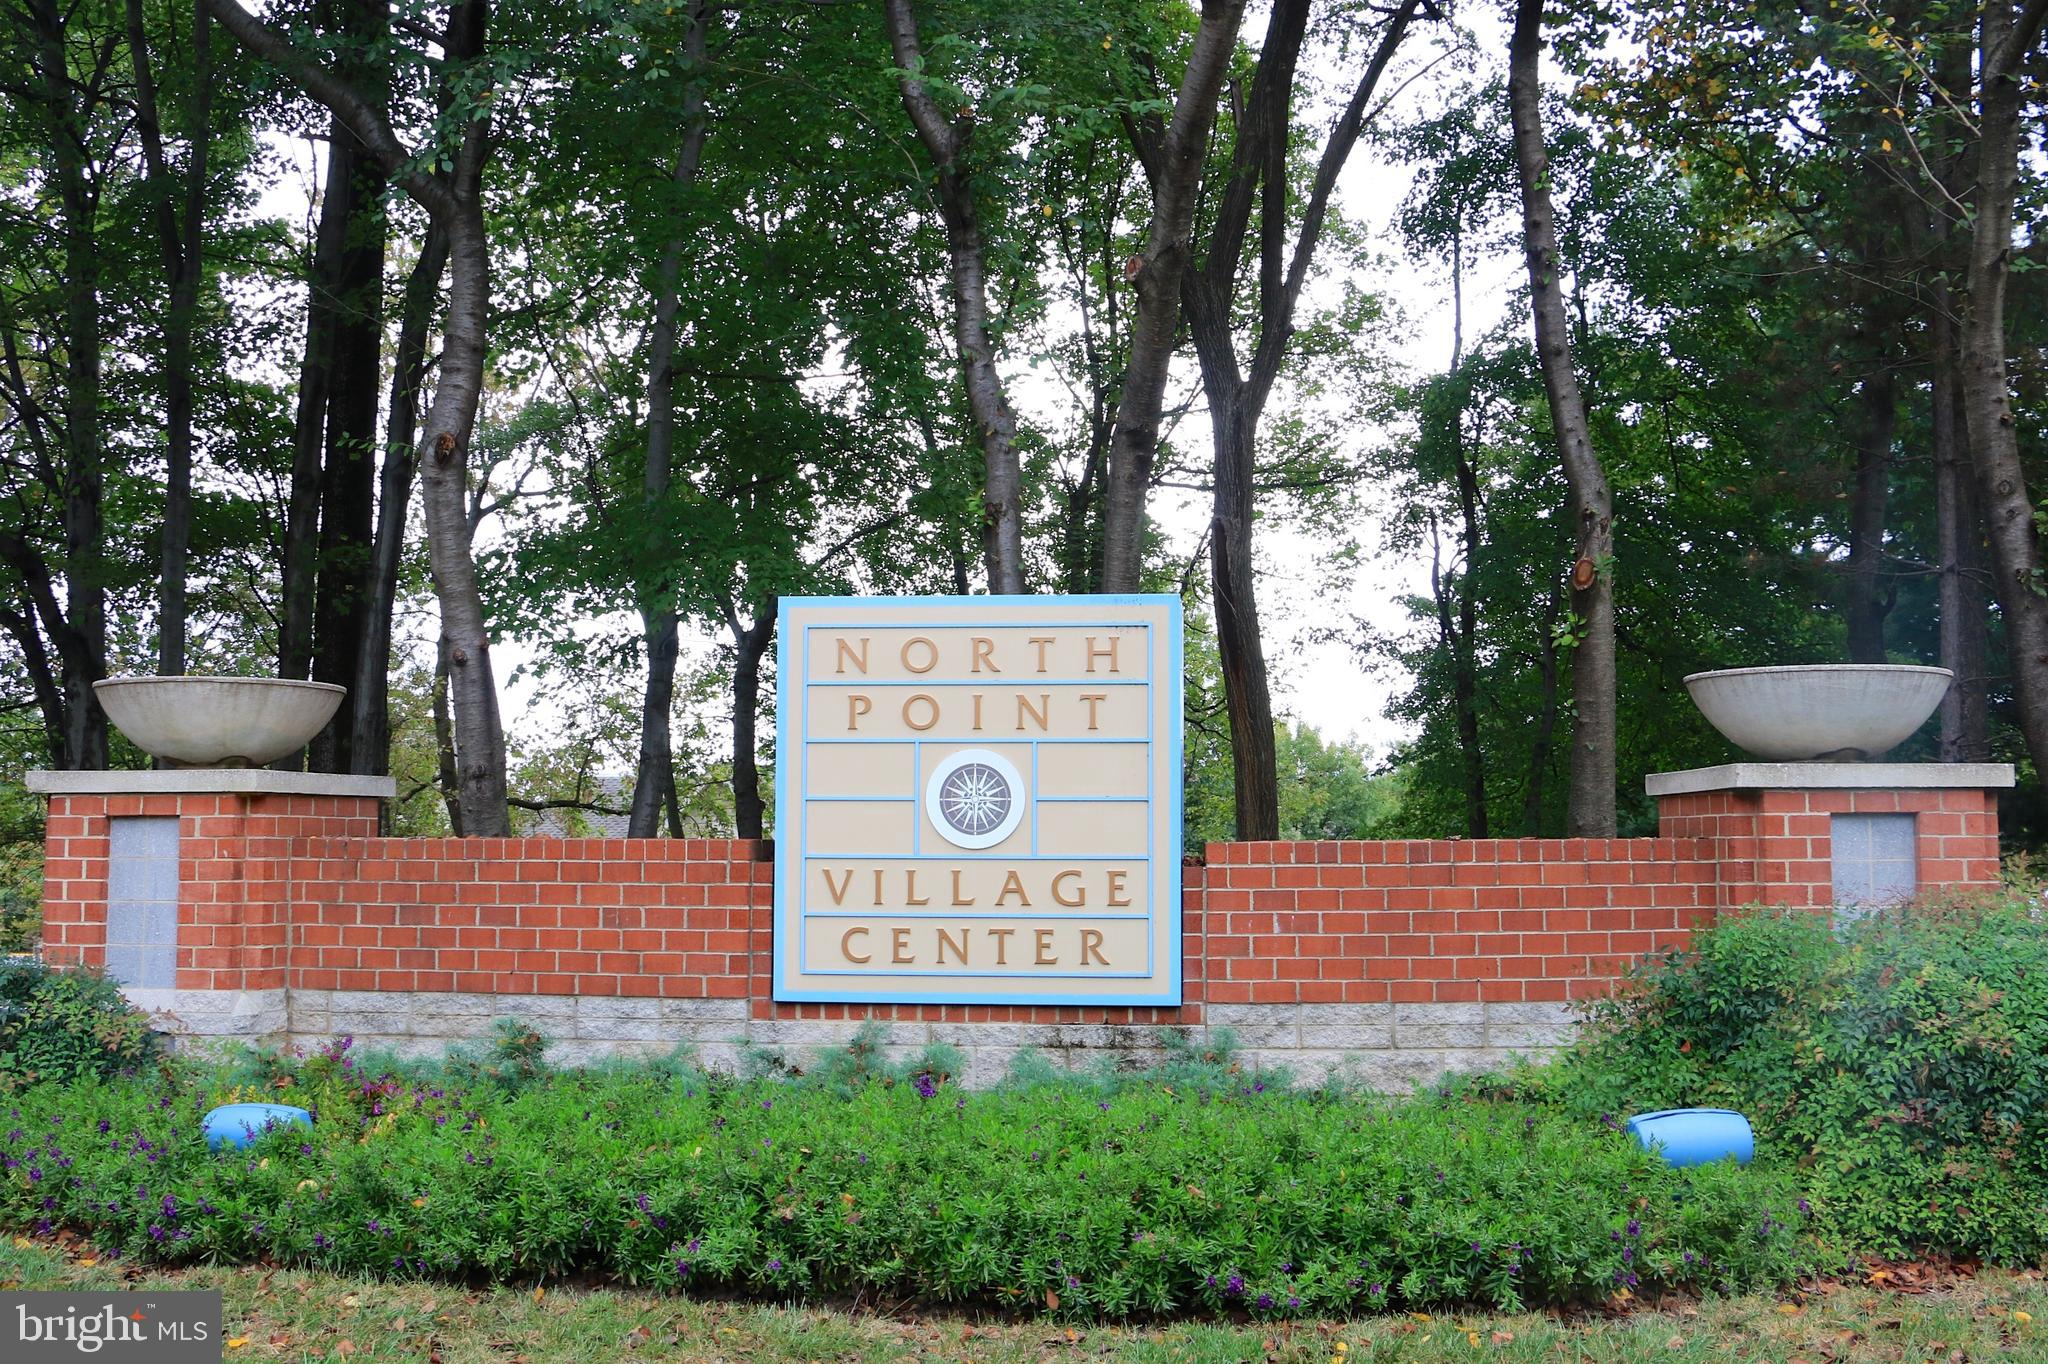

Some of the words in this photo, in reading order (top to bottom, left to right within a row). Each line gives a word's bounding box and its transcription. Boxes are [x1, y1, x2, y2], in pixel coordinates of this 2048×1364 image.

[835, 636, 1121, 674] NORTH
[846, 693, 1107, 731] POINT
[822, 868, 1133, 907] VILLAGE
[841, 926, 1111, 965] CENTER
